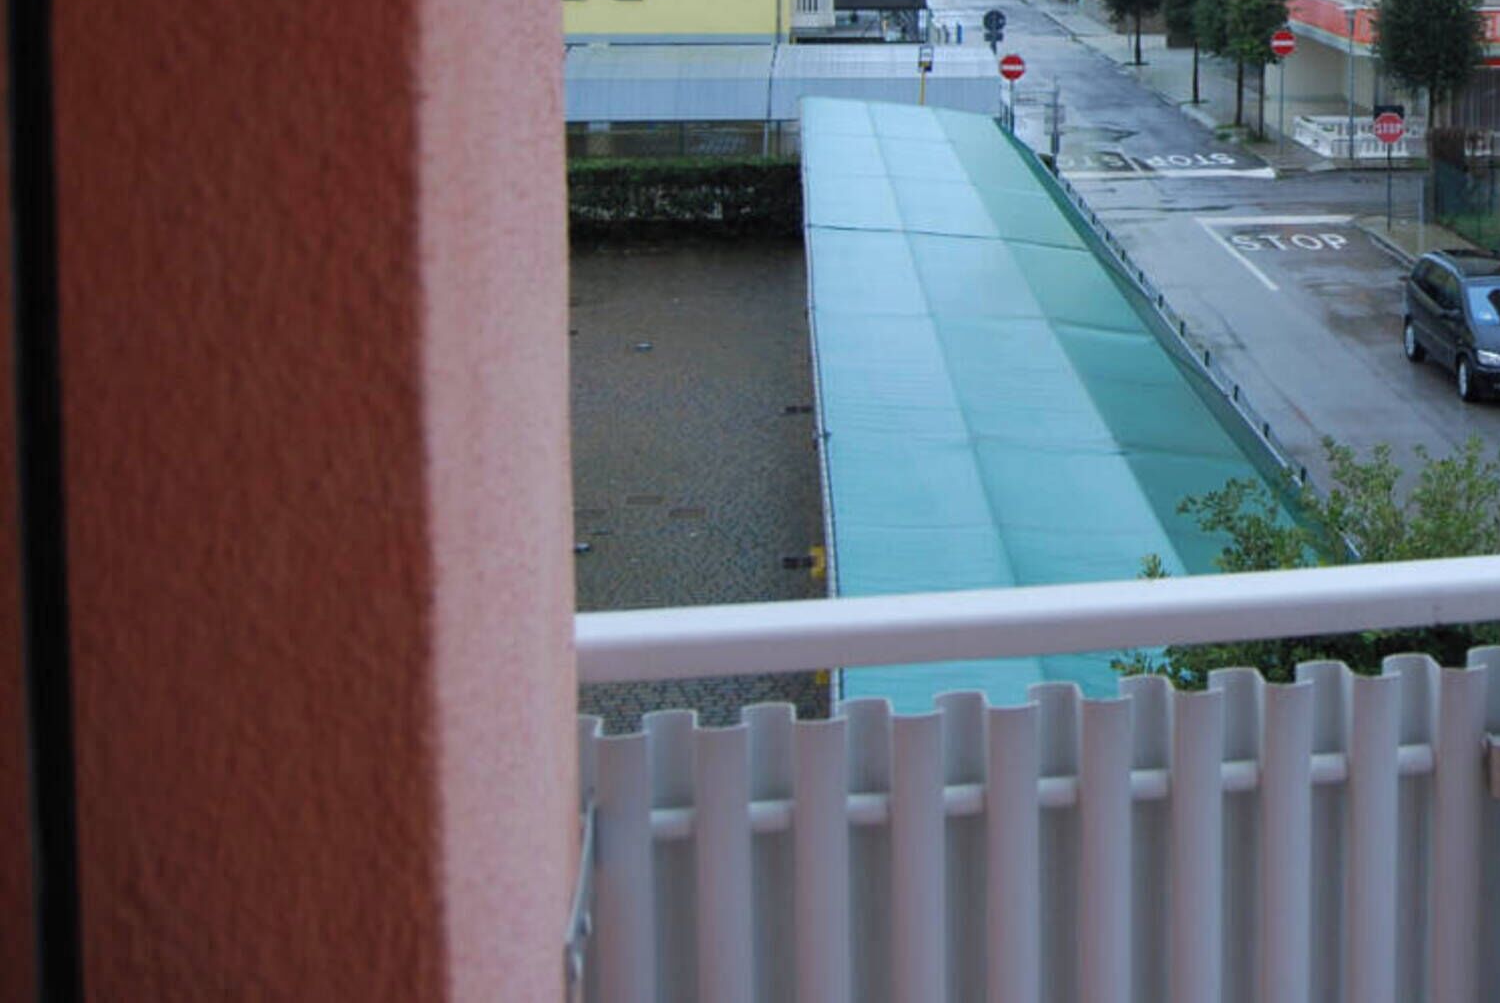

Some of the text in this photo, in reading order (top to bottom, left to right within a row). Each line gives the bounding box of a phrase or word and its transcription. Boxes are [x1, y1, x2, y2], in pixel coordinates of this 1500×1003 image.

[1374, 123, 1404, 134] STOP
[1145, 152, 1236, 167] STOP
[1231, 233, 1347, 251] STOP
